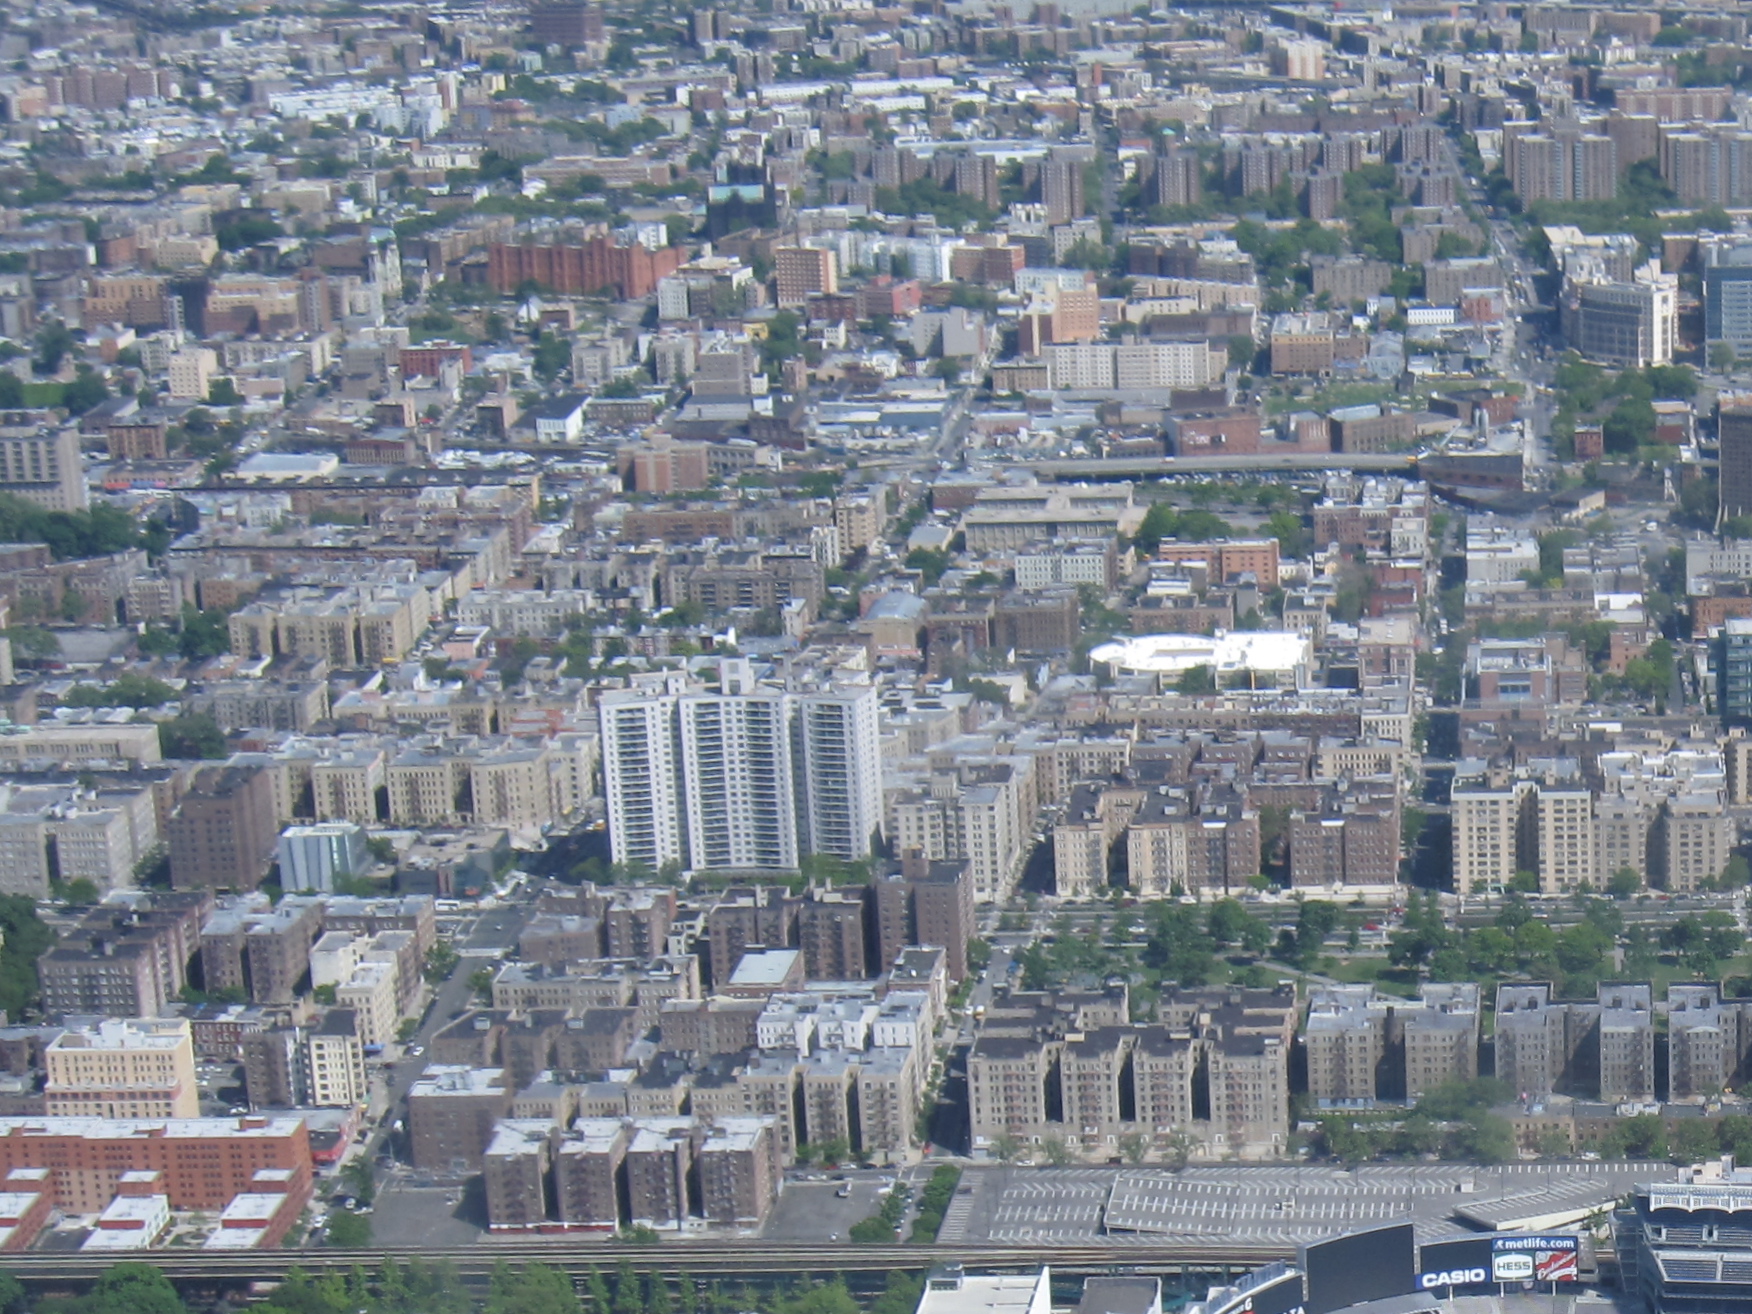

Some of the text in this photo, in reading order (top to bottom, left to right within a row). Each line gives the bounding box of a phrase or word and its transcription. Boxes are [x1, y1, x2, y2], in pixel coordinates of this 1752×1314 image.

[1505, 1237, 1575, 1249] metlife.com
[1496, 1261, 1531, 1271] HESS
[1422, 1268, 1486, 1288] CASIO
